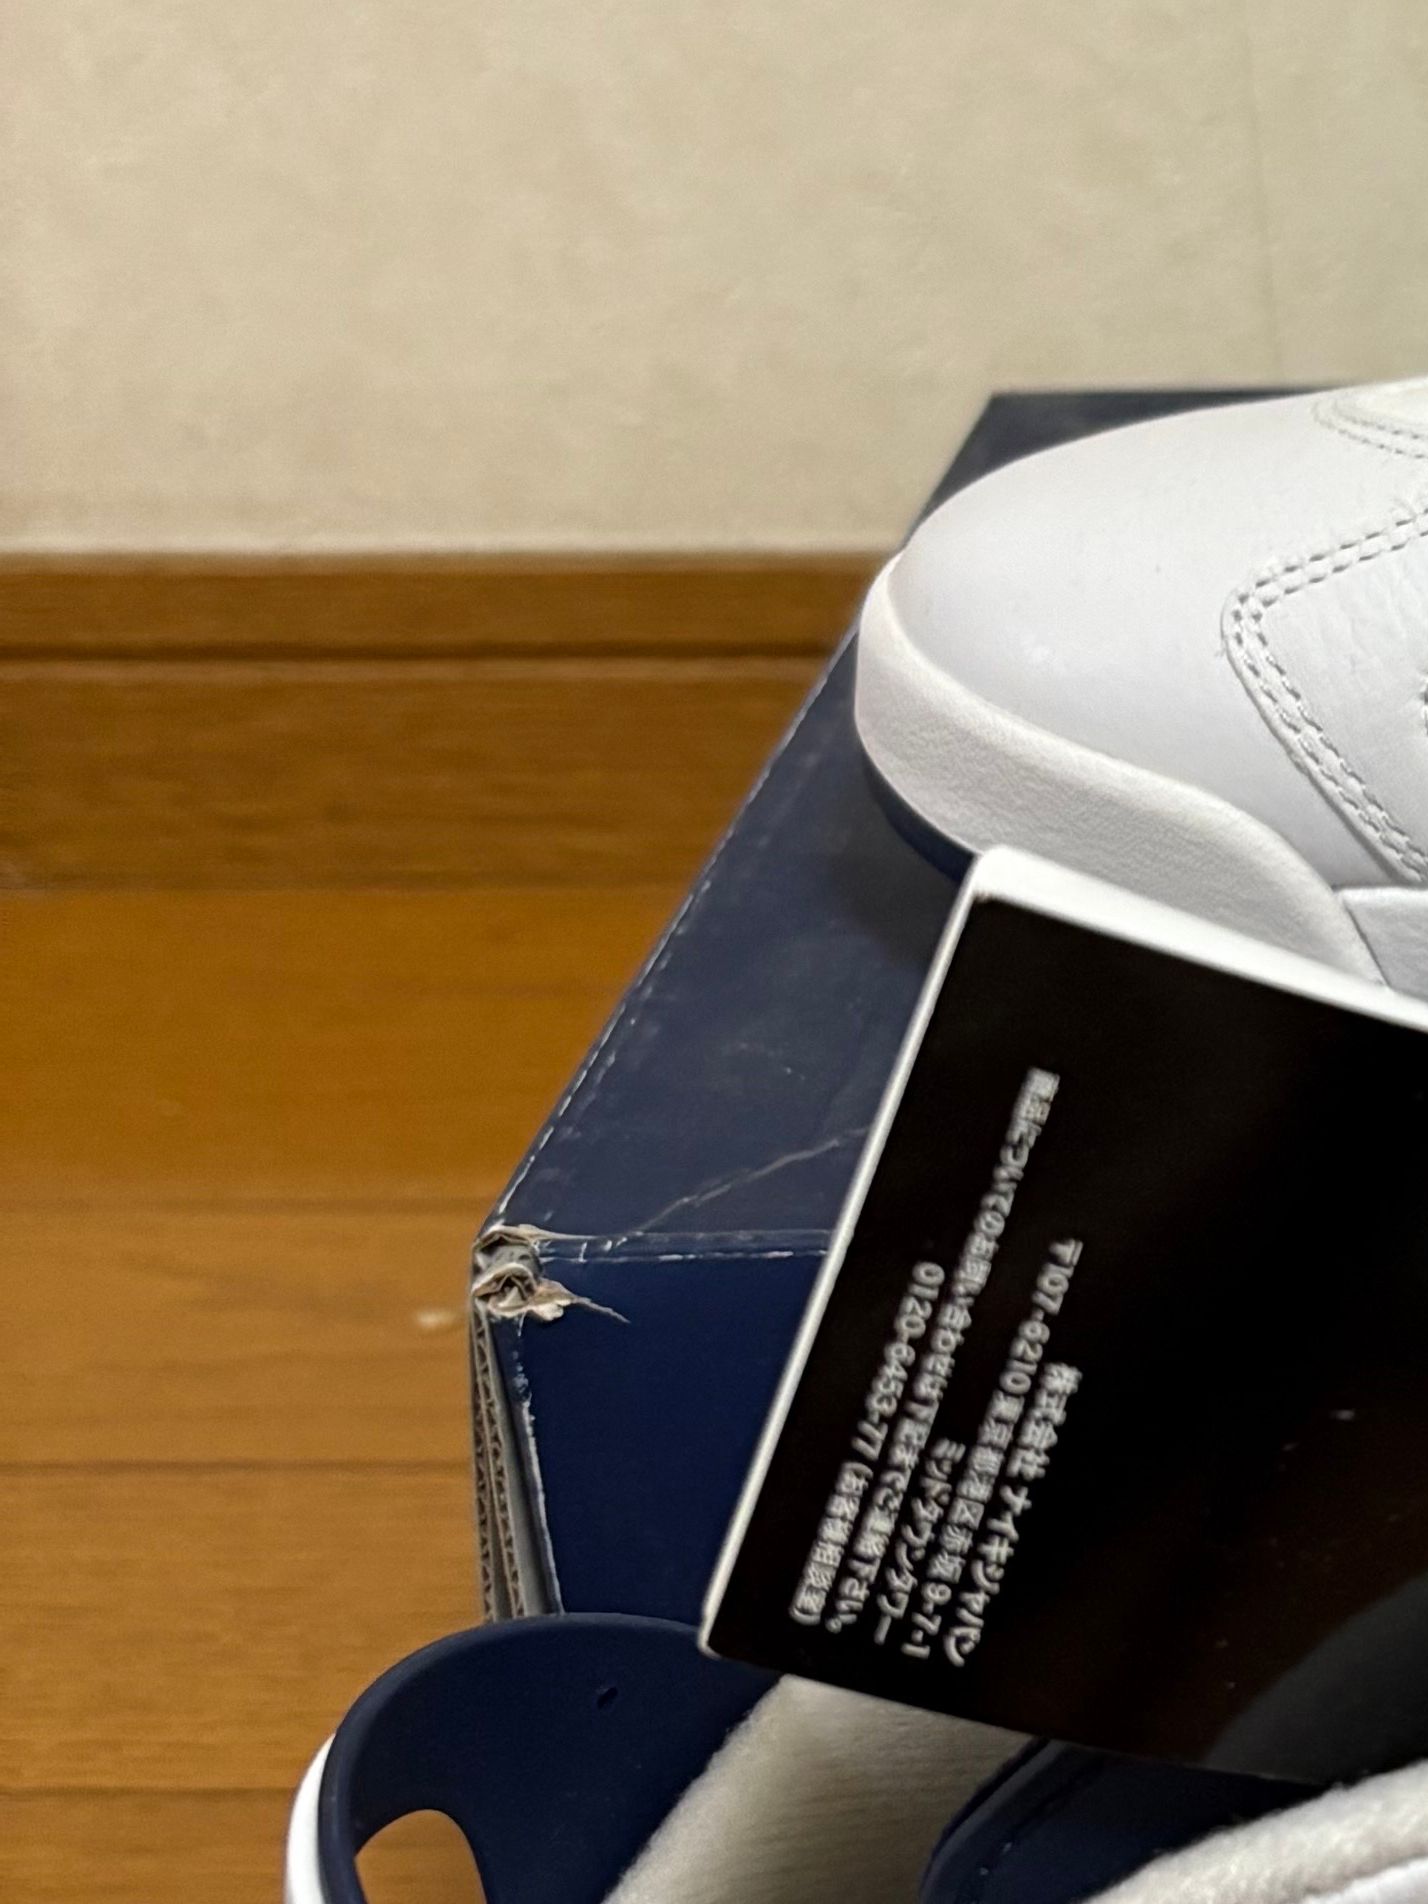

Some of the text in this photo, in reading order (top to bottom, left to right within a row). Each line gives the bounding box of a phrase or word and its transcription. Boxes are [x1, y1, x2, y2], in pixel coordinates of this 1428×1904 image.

[876, 1439, 965, 1642] ミッドタウンタワー
[945, 1362, 1082, 1665] 株式会社 ナイキジャパン
